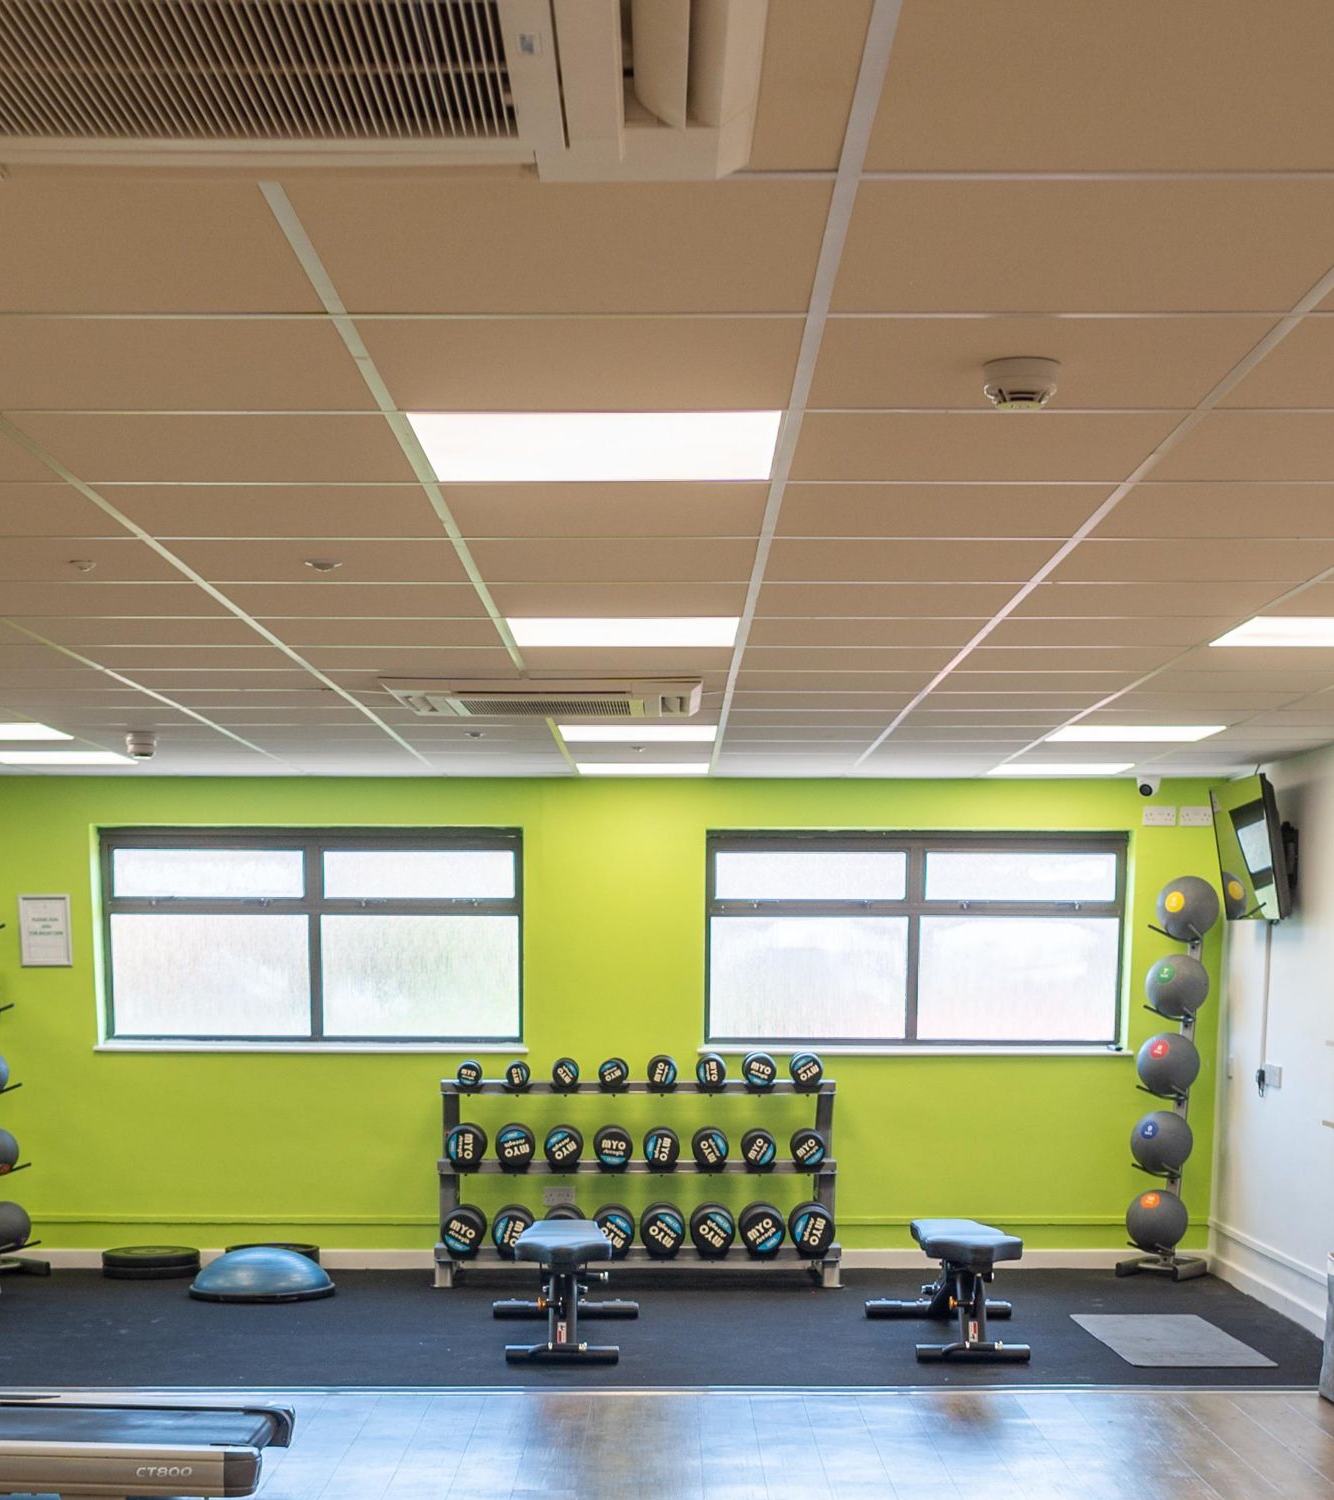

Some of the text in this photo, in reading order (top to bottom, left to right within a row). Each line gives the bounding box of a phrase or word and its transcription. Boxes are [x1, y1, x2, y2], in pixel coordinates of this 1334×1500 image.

[653, 1062, 665, 1083] MYO
[709, 1061, 718, 1082] MYO
[750, 1061, 772, 1075] MYO
[799, 1065, 820, 1081] MYO
[464, 1133, 474, 1160] MYO
[504, 1143, 530, 1158] MYO
[554, 1141, 577, 1160] MYO
[601, 1139, 627, 1150] MYO
[659, 1137, 671, 1161] MYO
[700, 1140, 717, 1163] MYO
[747, 1138, 764, 1160] MYO
[796, 1138, 816, 1158] MYO
[449, 1219, 476, 1239] MYO
[649, 1225, 675, 1248] MYO
[699, 1224, 725, 1248] MYO
[747, 1218, 773, 1241] MYO
[809, 1217, 826, 1246] MYO
[136, 1466, 193, 1478] CT800
